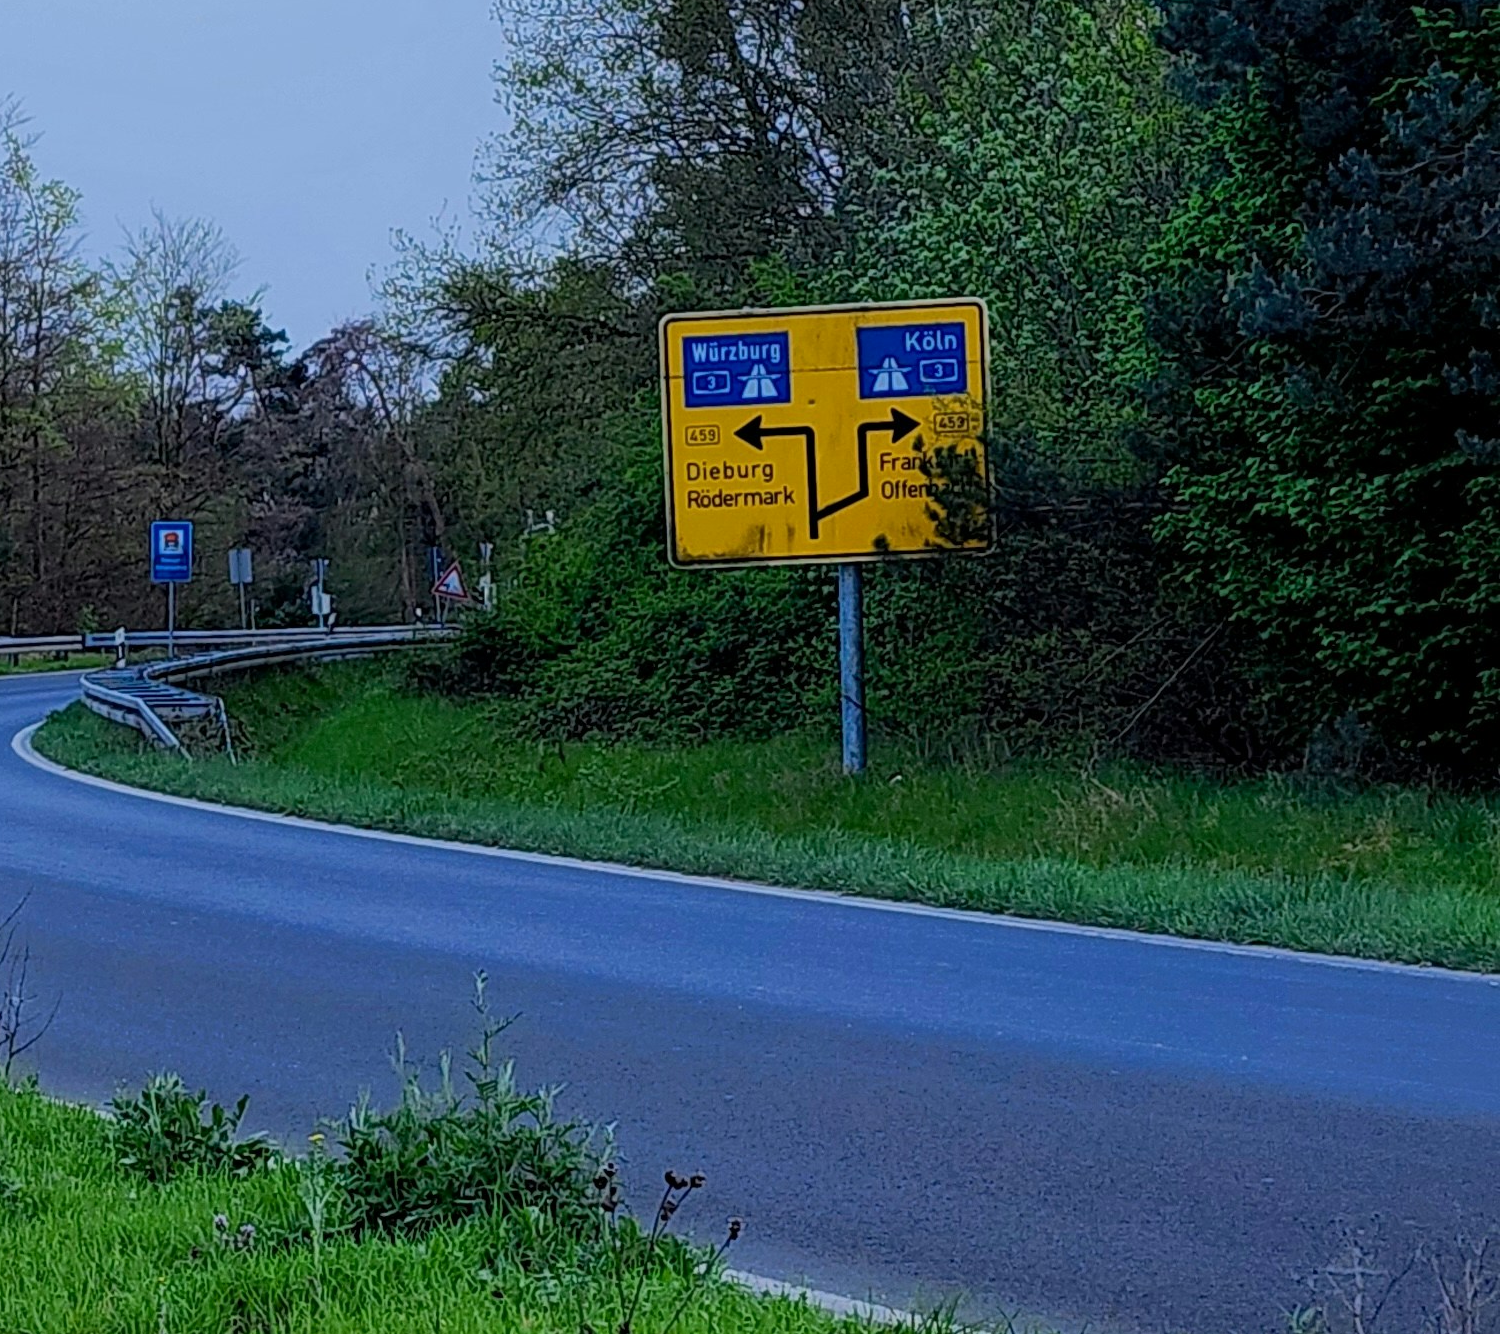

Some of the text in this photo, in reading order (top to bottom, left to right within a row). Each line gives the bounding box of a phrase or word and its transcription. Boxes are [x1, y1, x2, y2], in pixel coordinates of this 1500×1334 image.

[691, 340, 781, 364] Würzburg
[905, 329, 957, 352] Köln
[707, 375, 716, 389] 3
[934, 364, 944, 377] 3
[689, 429, 716, 441] 459
[879, 447, 974, 472] Frank
[686, 460, 774, 483] Dieburg
[687, 485, 796, 509] Rödermark
